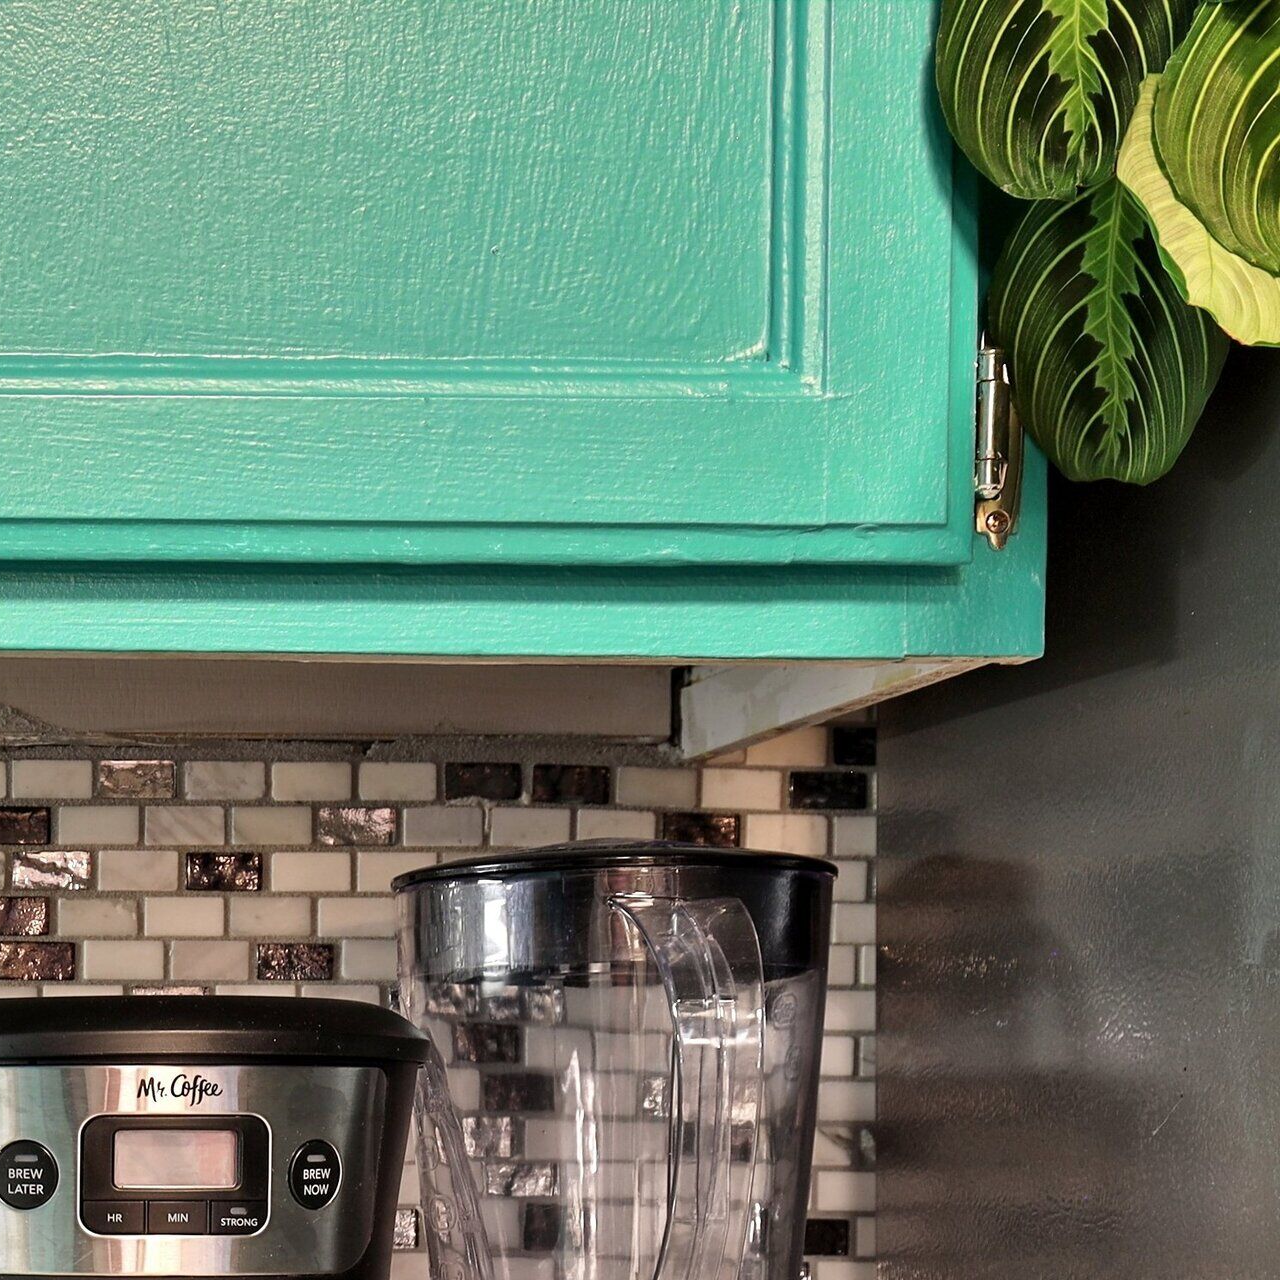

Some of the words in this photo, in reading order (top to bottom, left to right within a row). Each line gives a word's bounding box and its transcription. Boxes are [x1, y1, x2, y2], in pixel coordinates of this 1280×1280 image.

[137, 1076, 167, 1100] Mr.
[170, 1074, 224, 1106] Coffee
[8, 1168, 43, 1180] BREW
[303, 1168, 332, 1180] BREW
[8, 1183, 44, 1195] LATER
[303, 1183, 330, 1196] NOW
[107, 1213, 123, 1224] HR
[167, 1212, 189, 1223] MIN
[220, 1216, 259, 1228] STRONG
